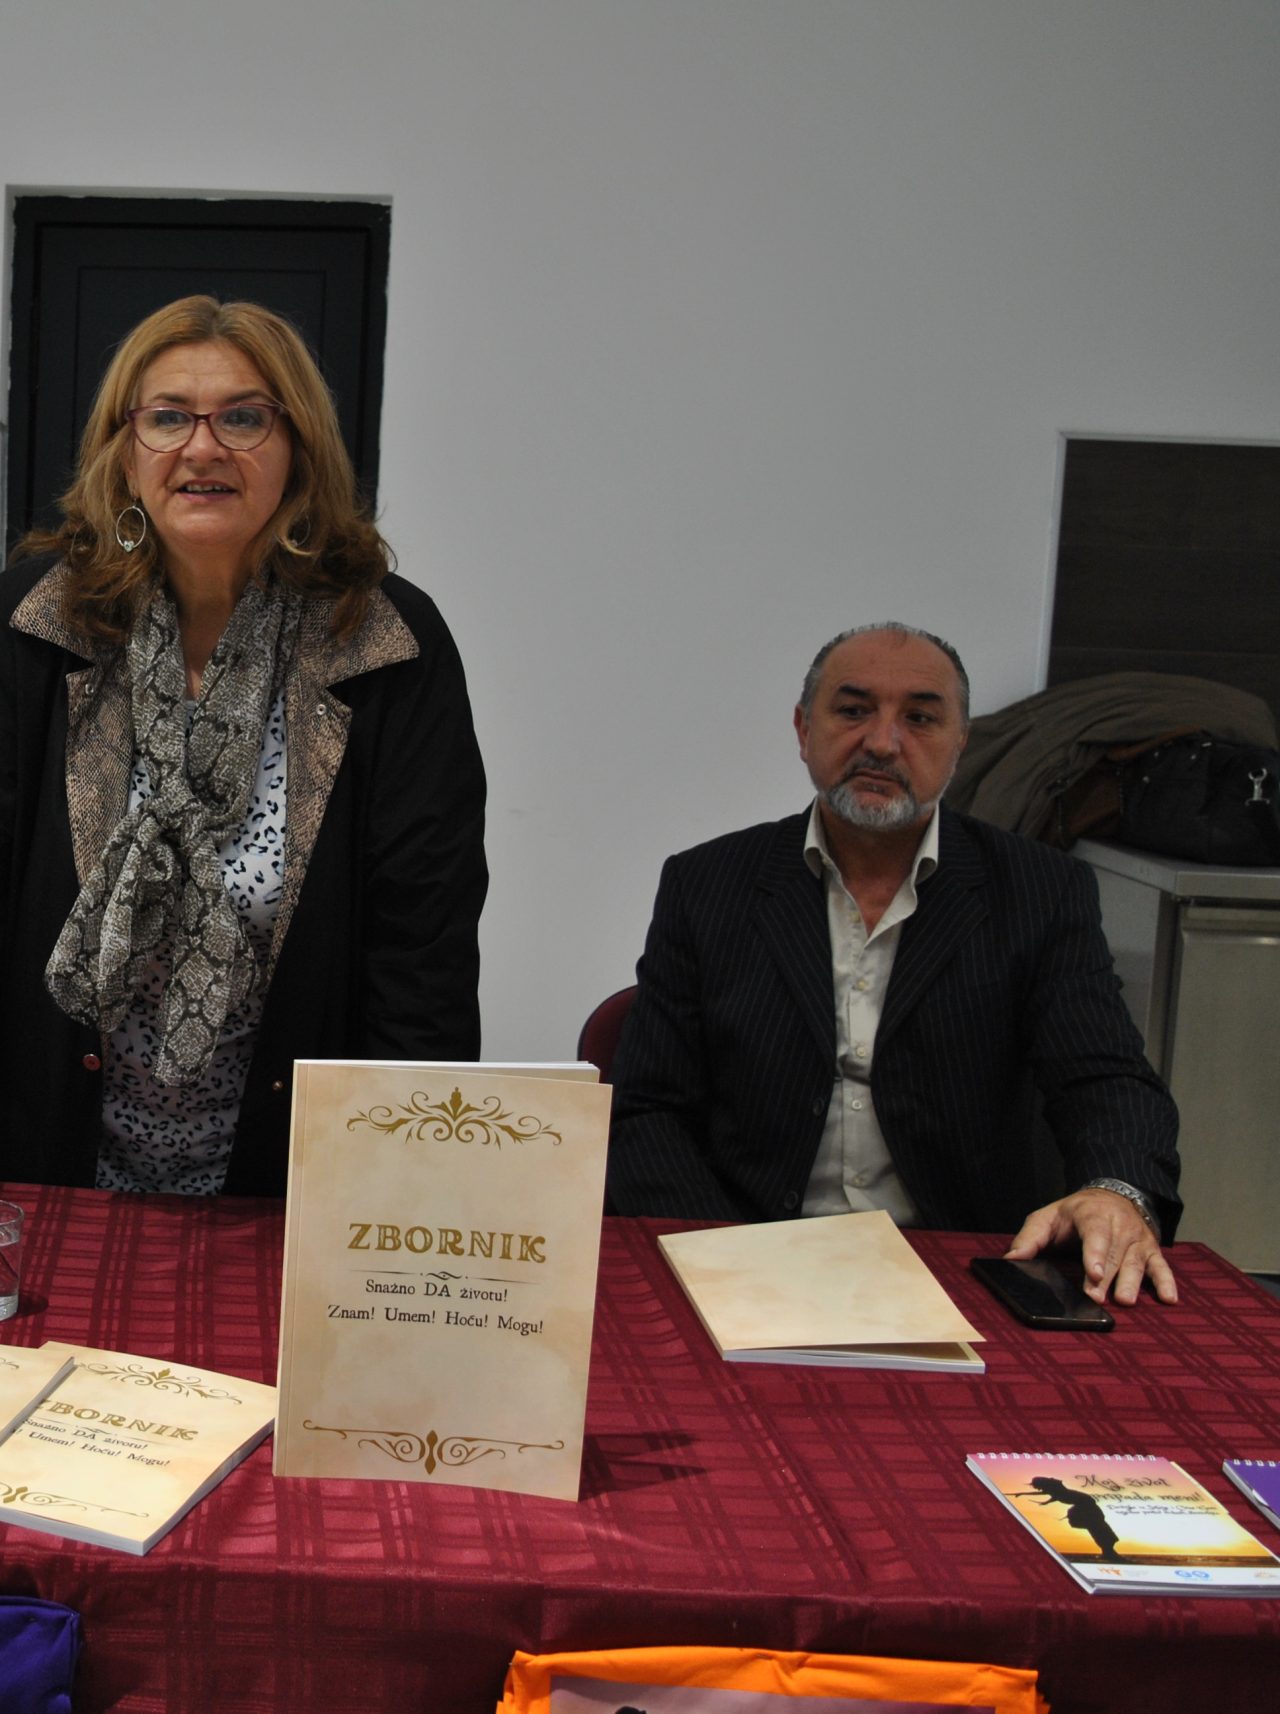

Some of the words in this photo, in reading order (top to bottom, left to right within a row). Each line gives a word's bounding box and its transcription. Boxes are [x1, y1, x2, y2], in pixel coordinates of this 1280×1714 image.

[347, 1223, 546, 1264] ZBORNIK
[424, 1282, 451, 1298] DA
[327, 1304, 375, 1321] Znam!
[384, 1307, 436, 1324] Umem!
[444, 1311, 488, 1328] Hoću!
[497, 1315, 544, 1336] Mogu!
[72, 1429, 97, 1441] DA
